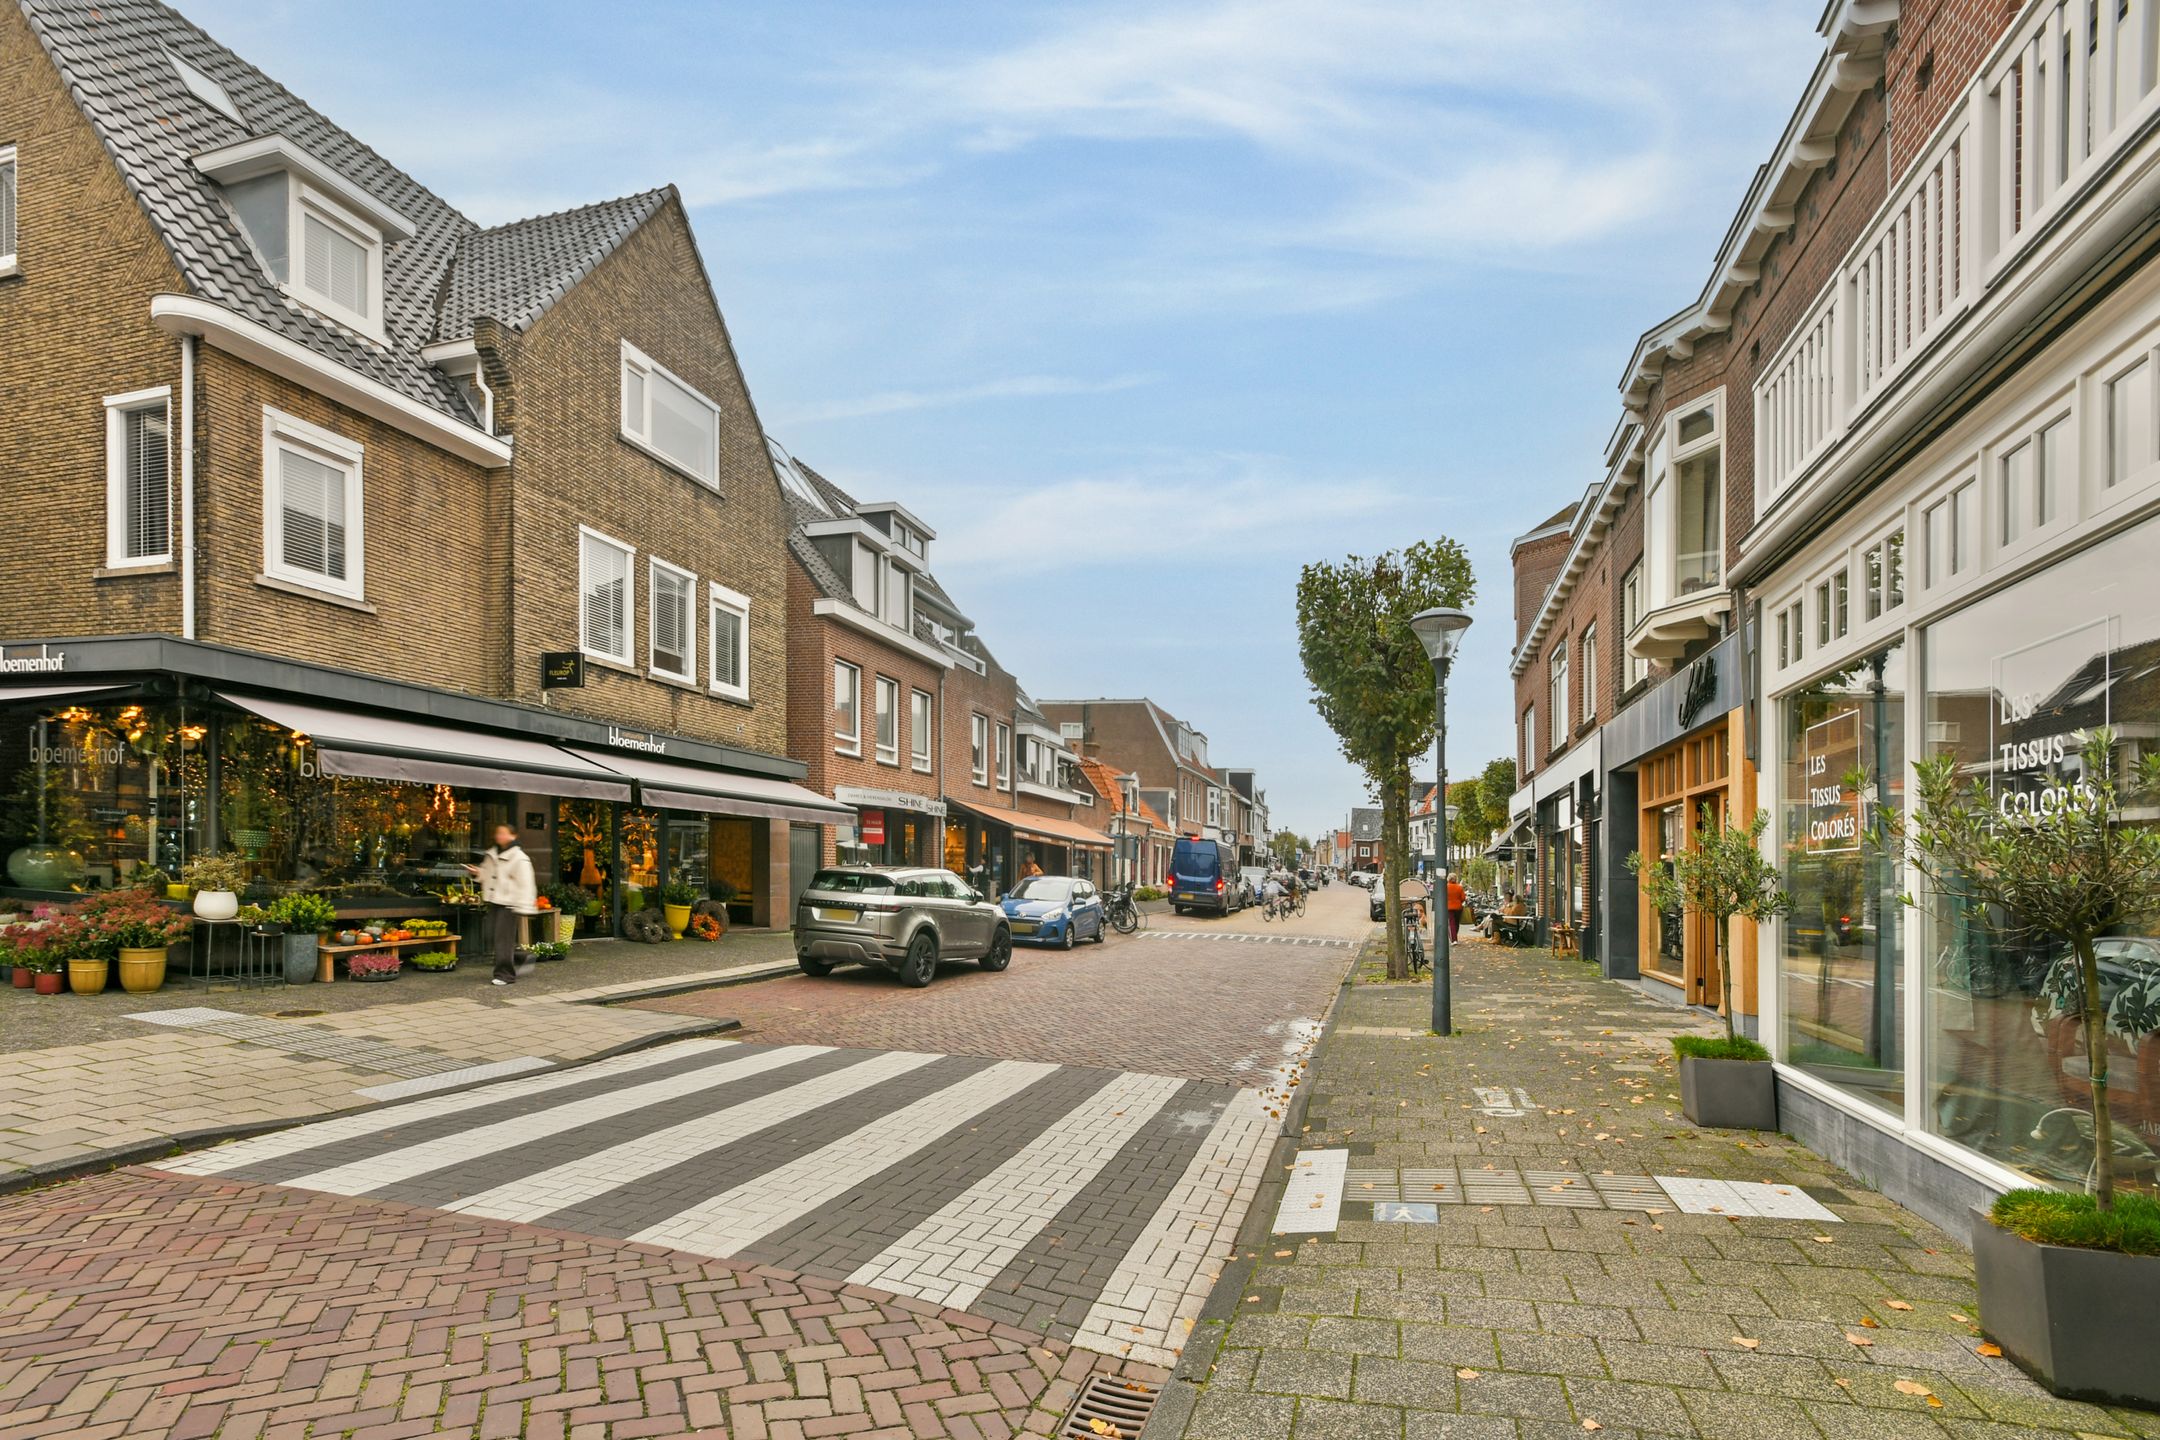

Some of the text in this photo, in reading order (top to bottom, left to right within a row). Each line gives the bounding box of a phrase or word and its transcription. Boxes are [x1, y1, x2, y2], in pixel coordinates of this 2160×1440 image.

[0, 644, 64, 672] loemenhof
[2000, 692, 2034, 725] LES
[609, 726, 665, 754] bloemenhof
[2000, 735, 2064, 772] TISSUS
[1811, 755, 1826, 776] LES
[898, 796, 923, 808] SHINE
[927, 804, 945, 815] SHINE
[1811, 785, 1841, 808] TISSUS
[1811, 812, 1855, 841] COLORÉS
